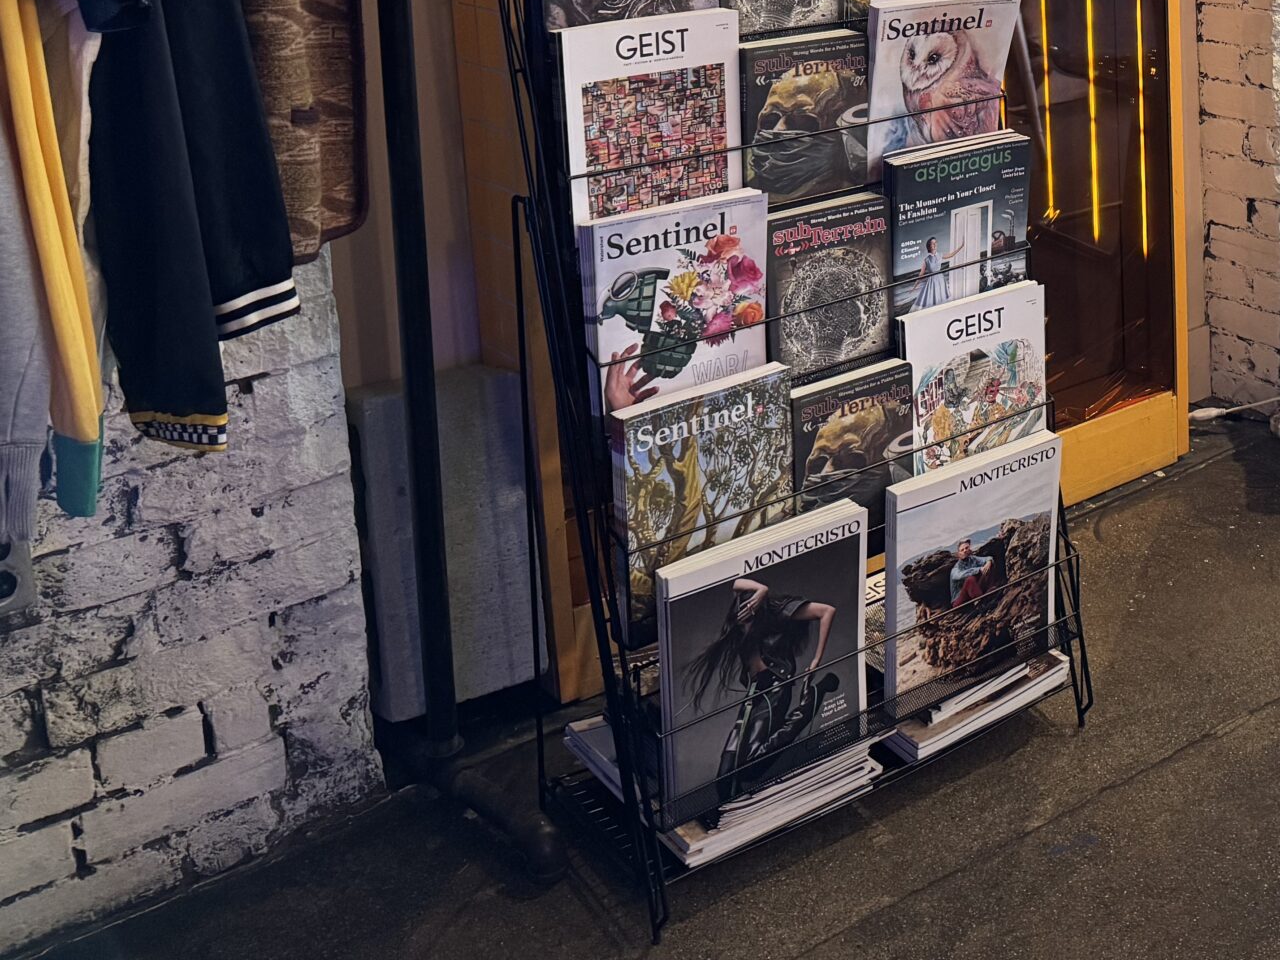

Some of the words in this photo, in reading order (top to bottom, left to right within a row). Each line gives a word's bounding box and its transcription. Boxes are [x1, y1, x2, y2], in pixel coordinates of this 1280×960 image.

[886, 8, 985, 40] Sentinel
[616, 28, 689, 60] GEIST
[915, 150, 1012, 183] asparagus
[899, 202, 915, 212] The
[915, 196, 947, 209] Monster
[948, 193, 955, 201] in
[956, 189, 973, 199] Your
[974, 184, 996, 194] Closet
[907, 207, 937, 219] Fashion
[606, 212, 726, 260] Sentinel
[947, 307, 1004, 340] GEIST
[637, 392, 754, 452] Sentinel
[960, 446, 1056, 493] MONTECRISTO
[743, 520, 860, 574] MONTECRISTO
